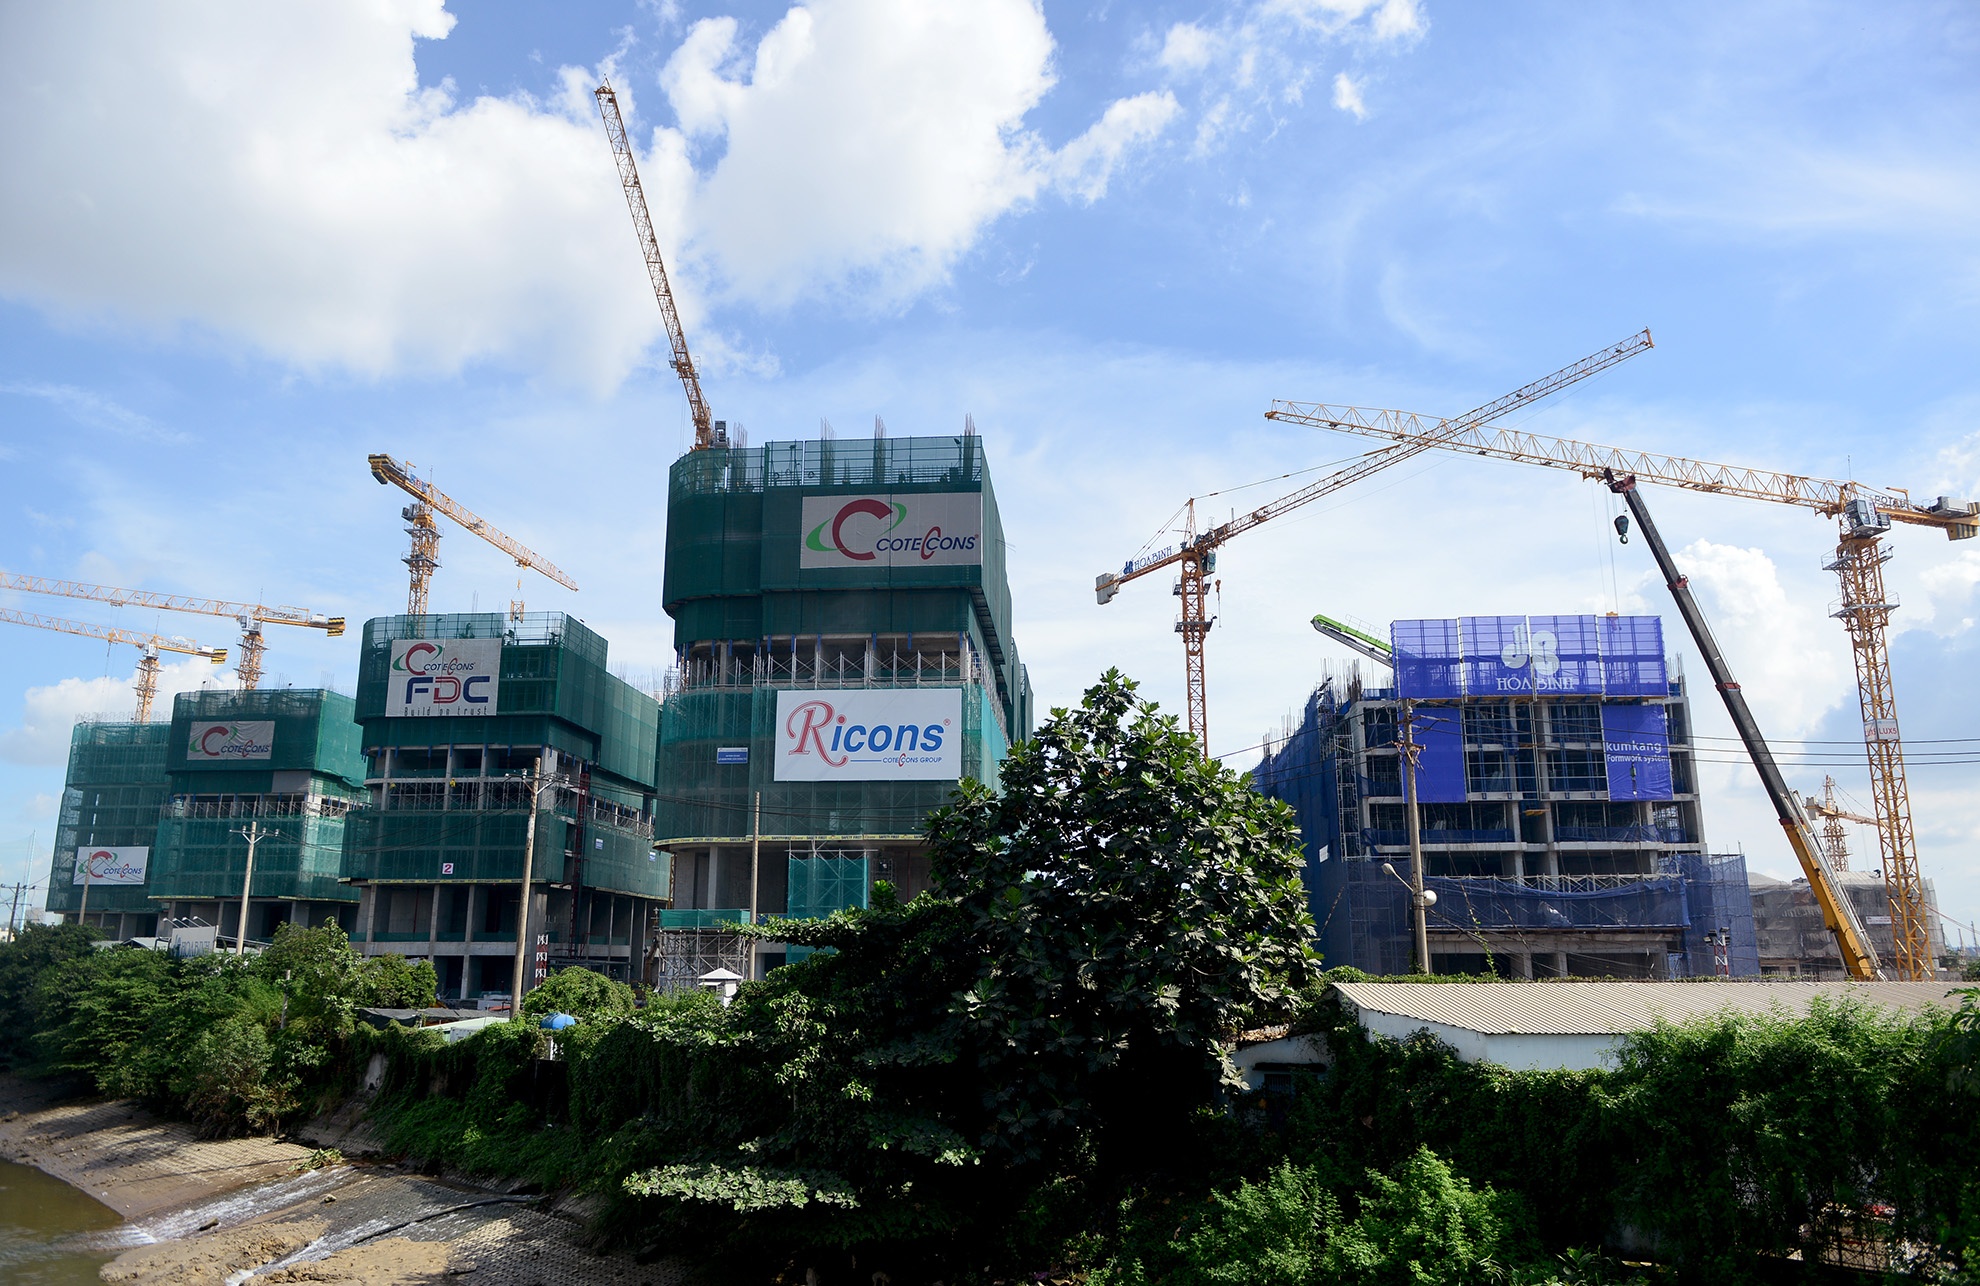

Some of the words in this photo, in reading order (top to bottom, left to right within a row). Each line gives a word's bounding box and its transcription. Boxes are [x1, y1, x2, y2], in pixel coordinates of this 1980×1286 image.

[405, 676, 490, 704] FDC
[404, 706, 431, 716] Build
[457, 705, 487, 716] trust
[786, 700, 945, 768] Ricons
[1605, 740, 1662, 754] kumkang
[1606, 753, 1643, 763] Formwork
[1643, 754, 1669, 764] system
[444, 863, 453, 873] 2
